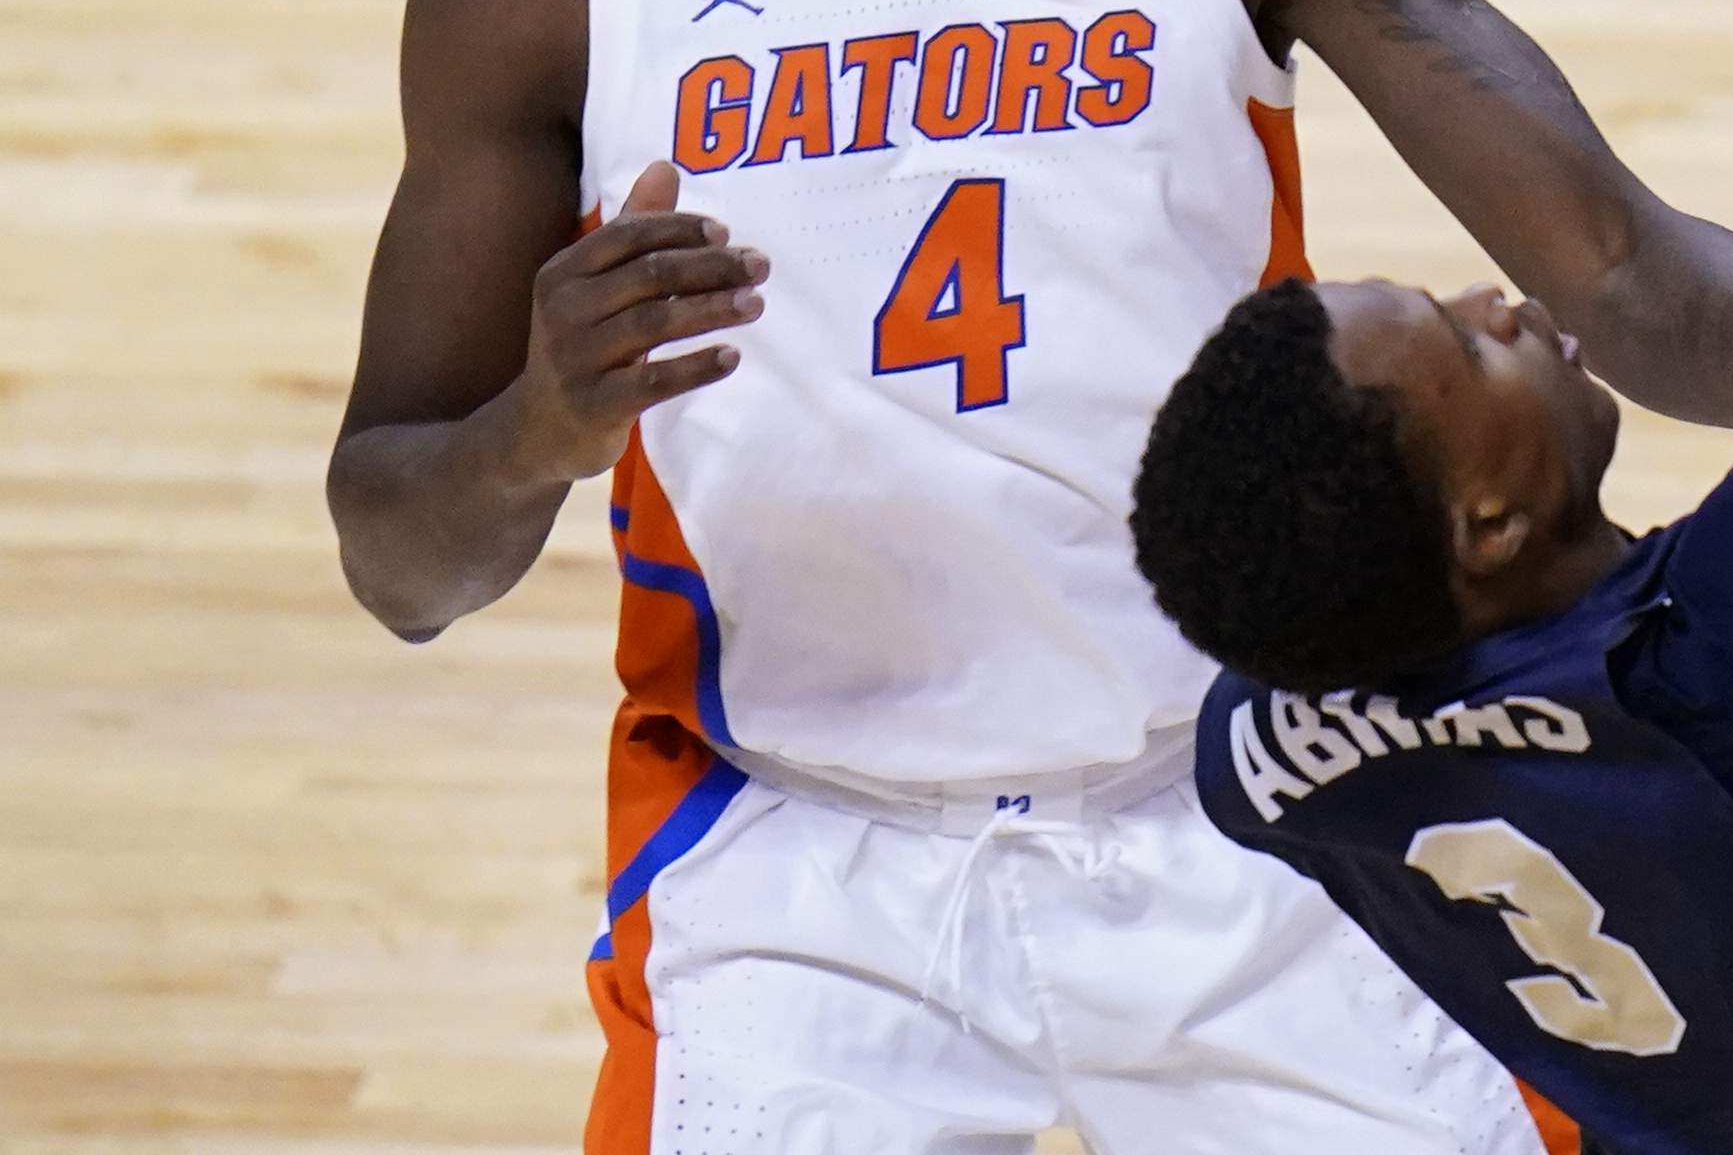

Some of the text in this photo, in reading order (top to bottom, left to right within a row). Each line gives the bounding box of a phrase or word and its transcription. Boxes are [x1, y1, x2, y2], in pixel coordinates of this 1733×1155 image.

[672, 9, 1156, 176] GATORS
[871, 177, 1028, 415] 4
[1403, 817, 1688, 1057] 3
